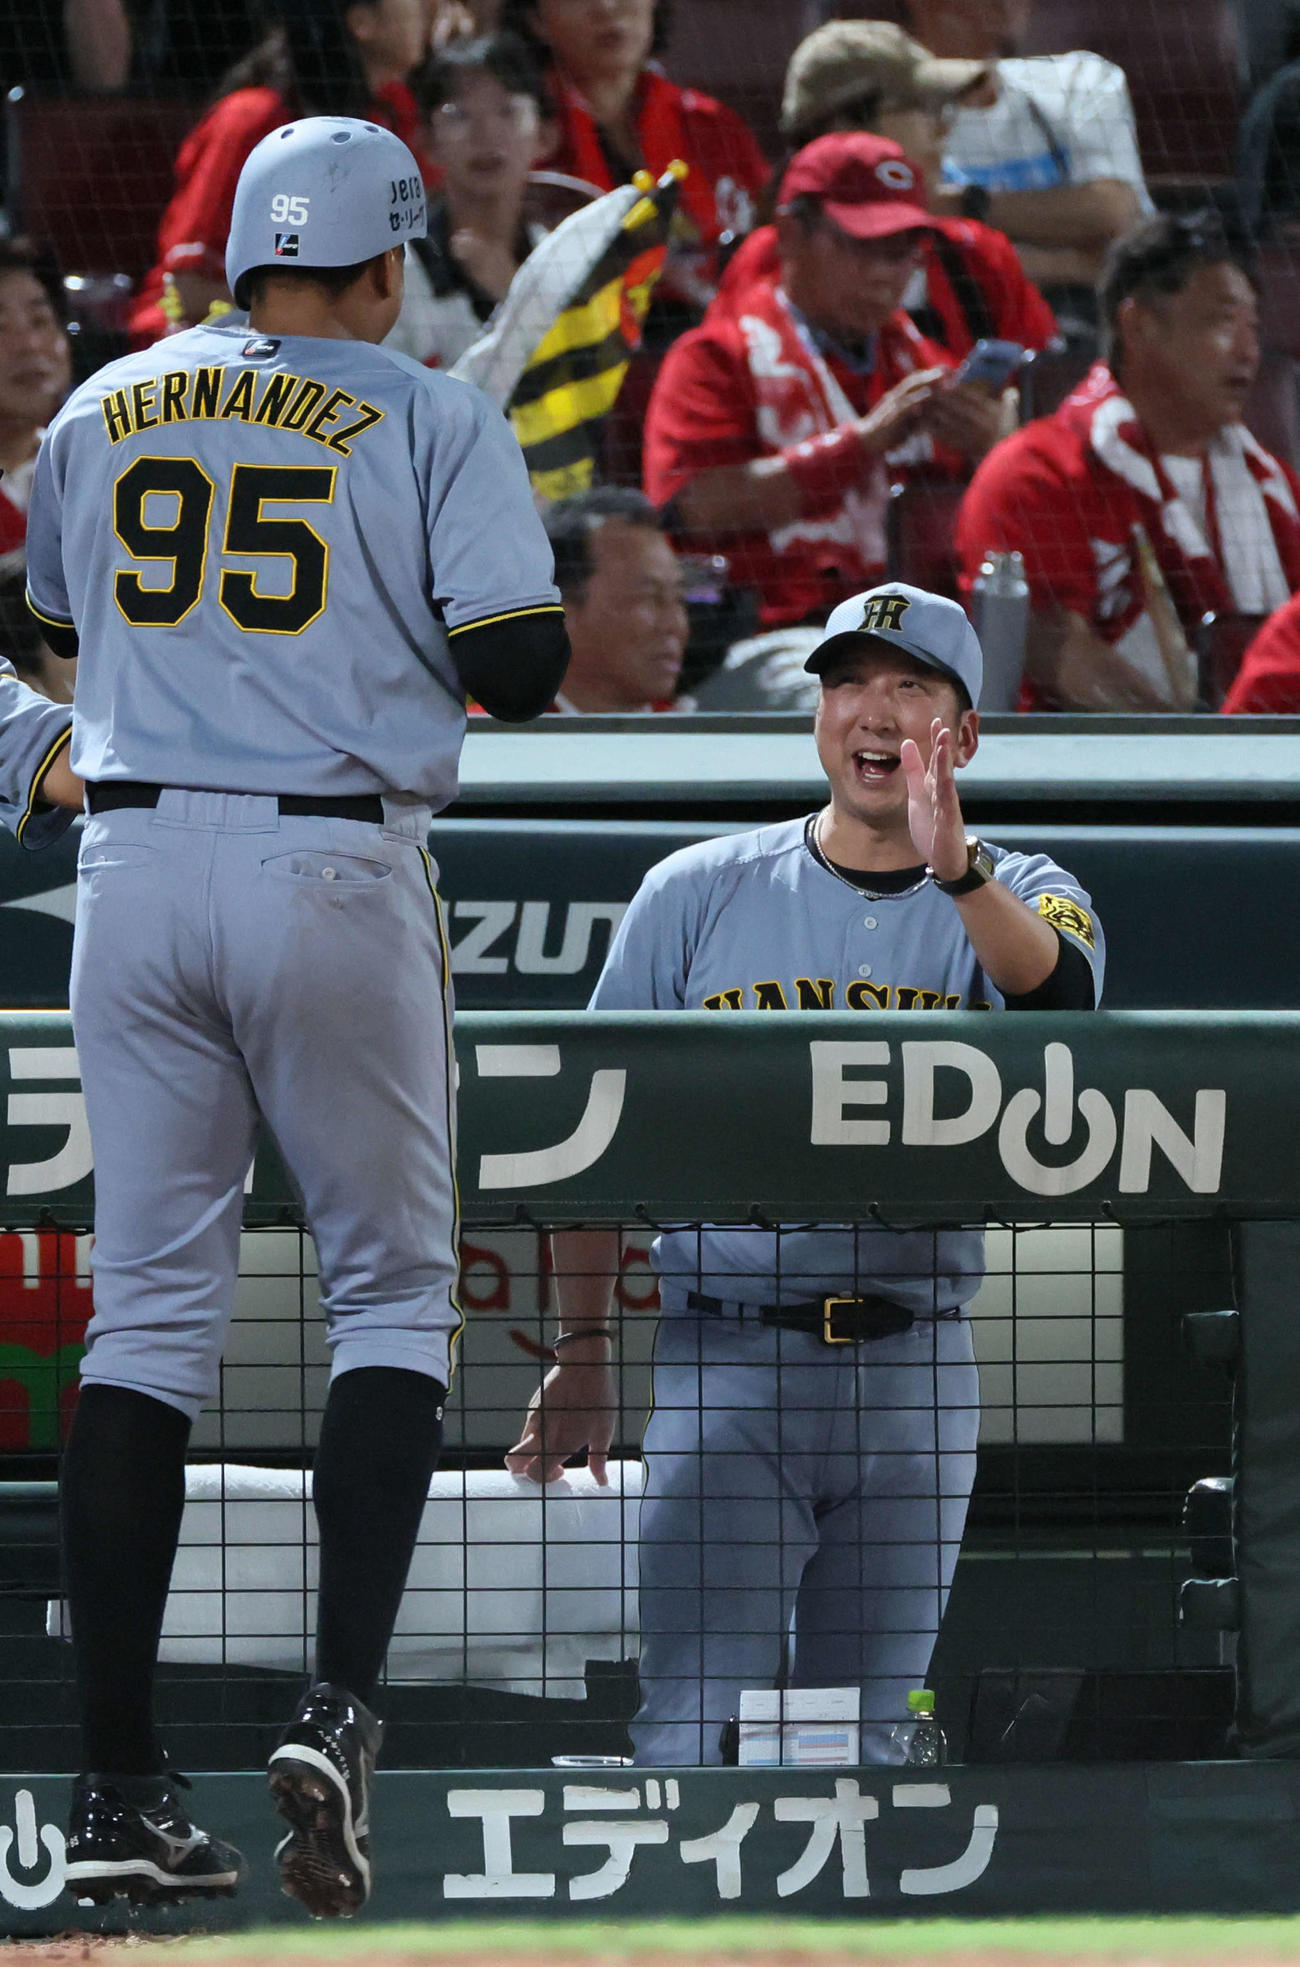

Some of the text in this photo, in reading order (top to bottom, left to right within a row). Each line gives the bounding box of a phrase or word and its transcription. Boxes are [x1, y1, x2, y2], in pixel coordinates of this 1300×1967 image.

[270, 194, 310, 226] 95
[101, 366, 386, 457] HERNANDEZ
[113, 455, 338, 636] 95
[442, 1778, 1000, 1899] エディオン
